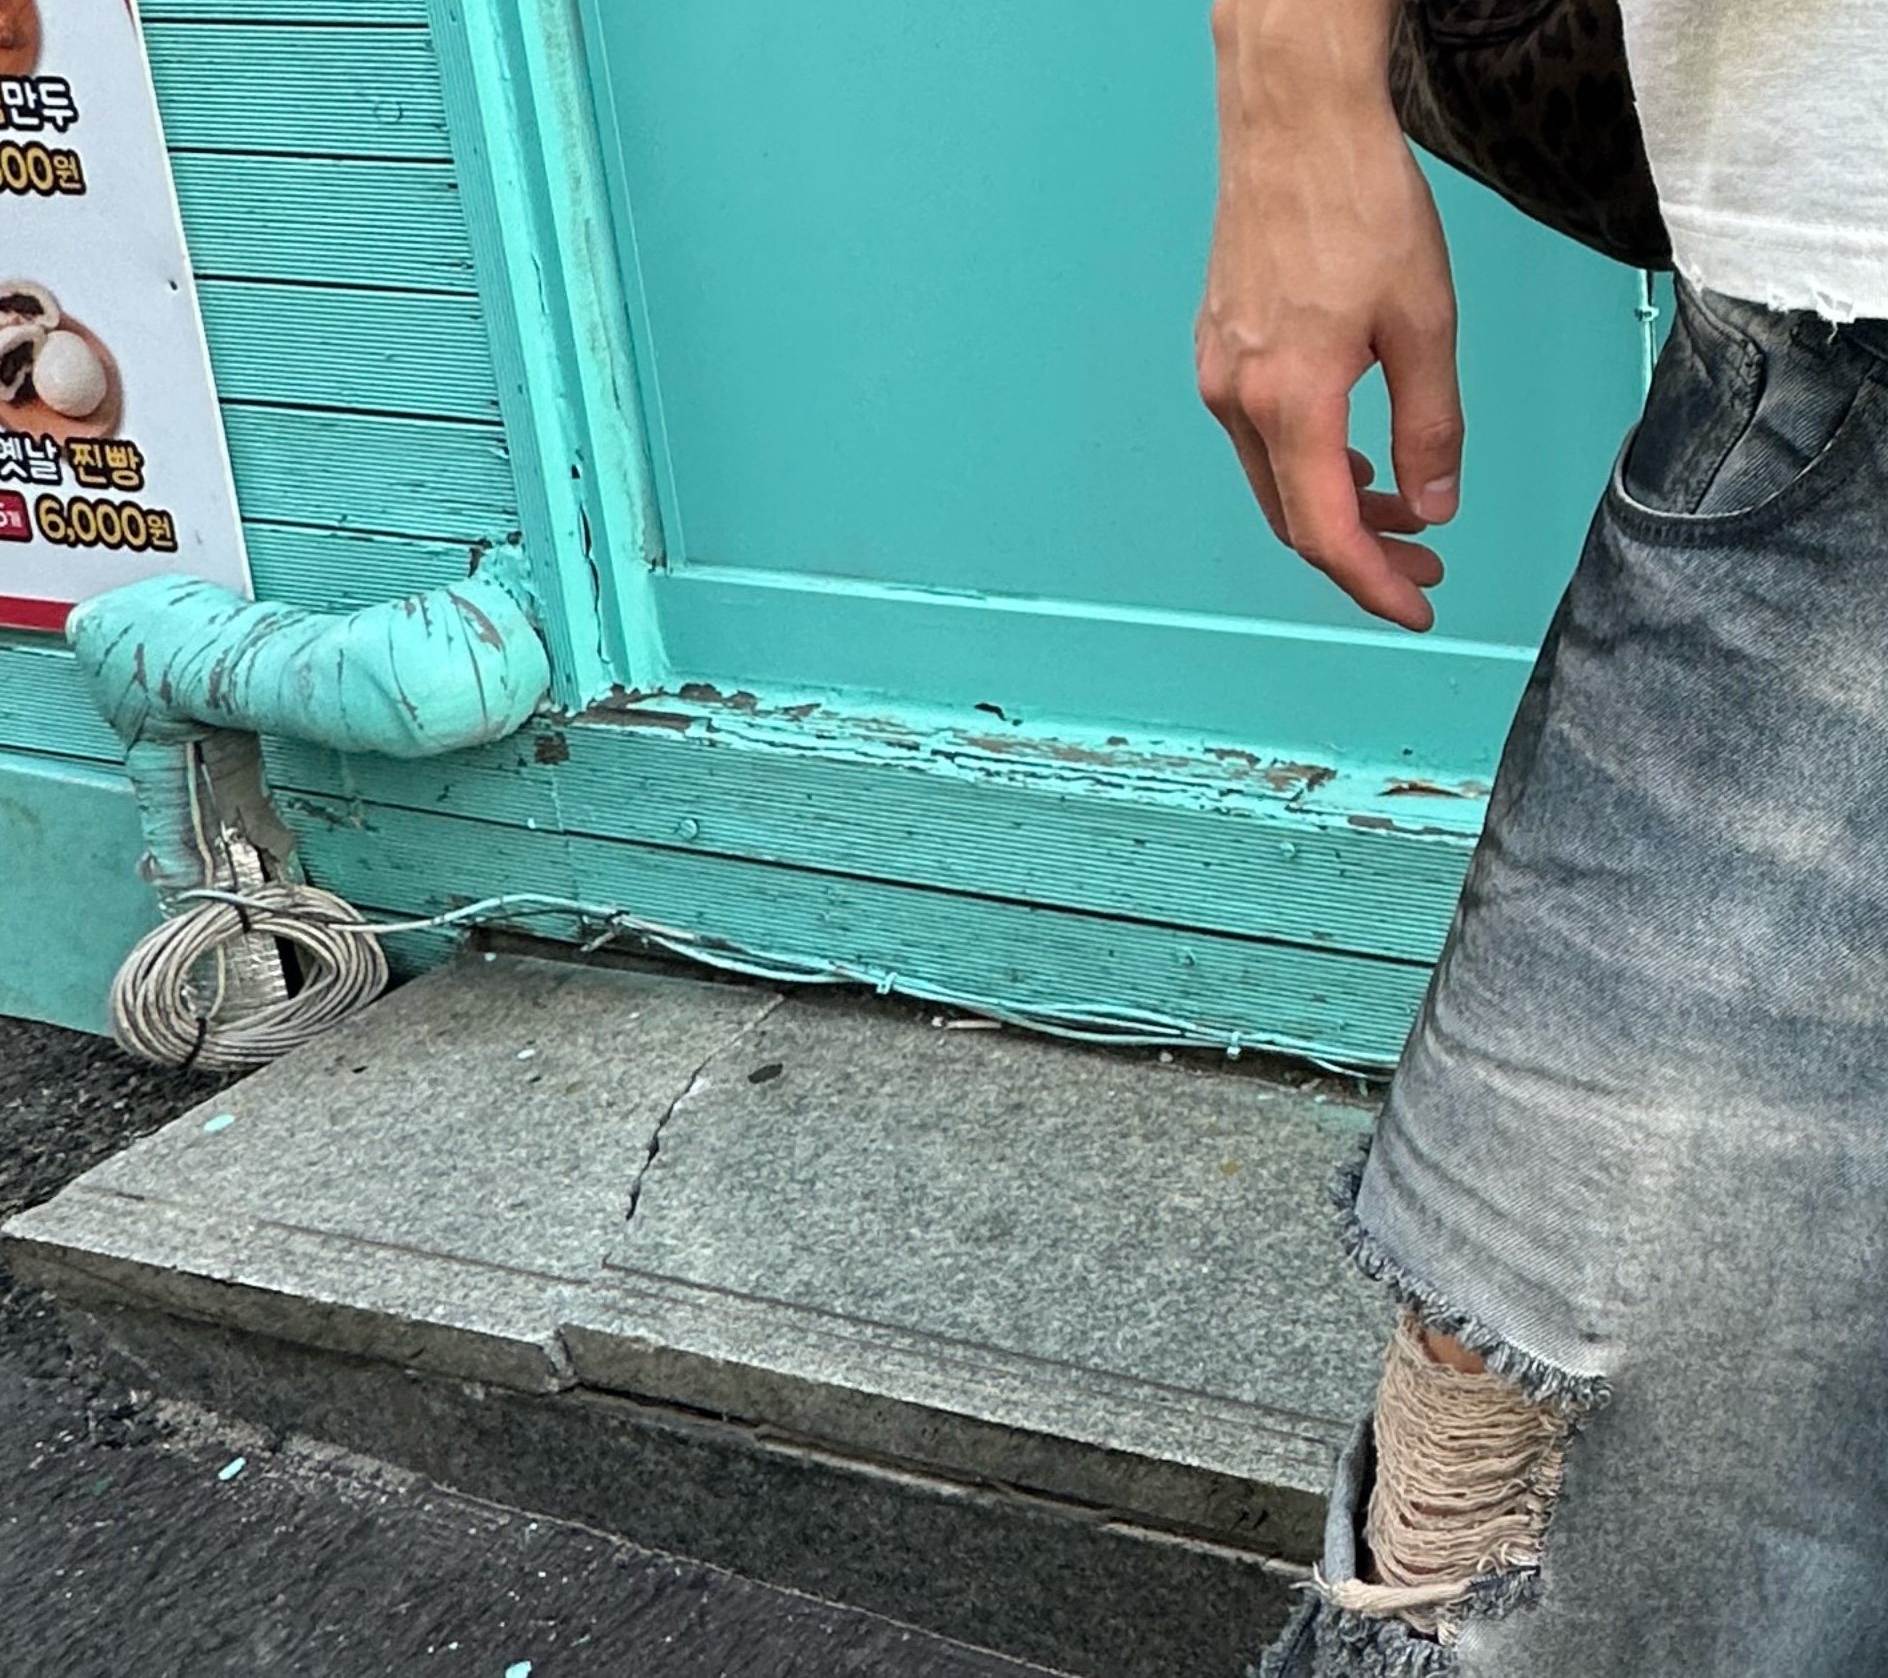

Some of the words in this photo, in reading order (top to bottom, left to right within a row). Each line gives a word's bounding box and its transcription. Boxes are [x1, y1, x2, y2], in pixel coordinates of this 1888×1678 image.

[0, 79, 78, 131] 만두
[0, 145, 84, 192] 00원
[68, 441, 143, 487] 찐빵
[38, 497, 175, 549] 6,000원
